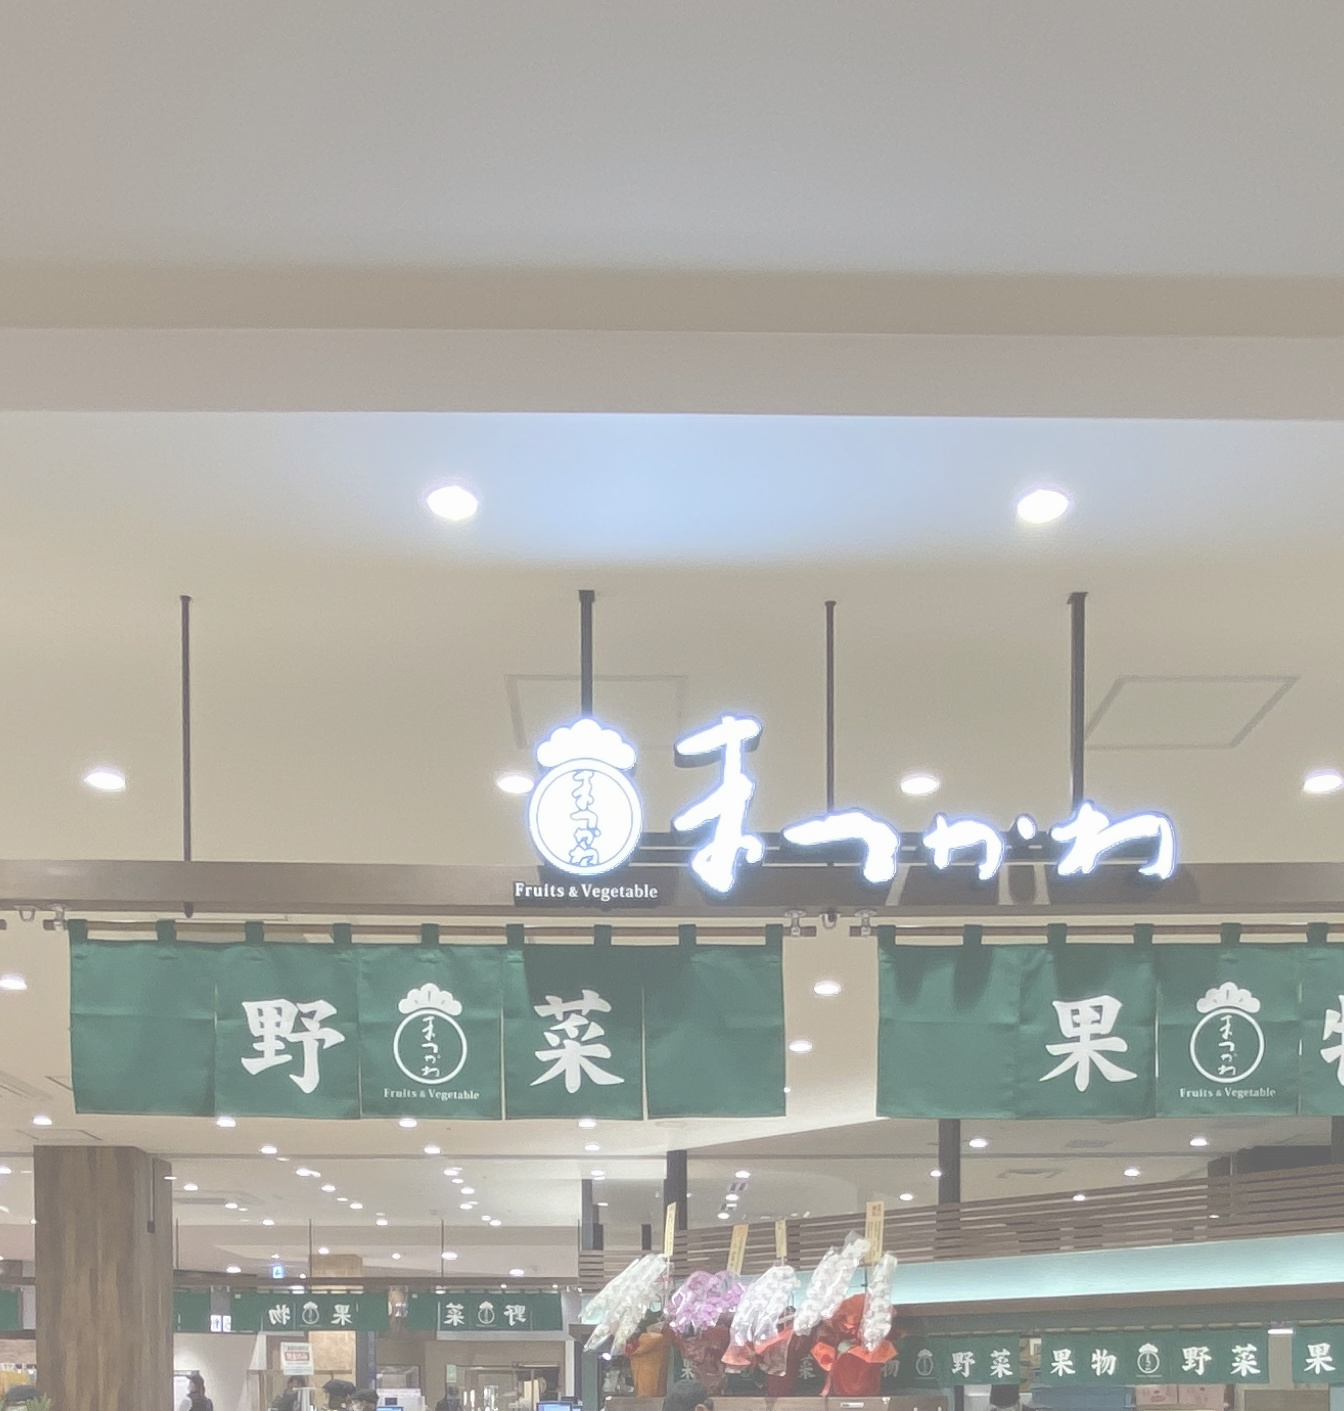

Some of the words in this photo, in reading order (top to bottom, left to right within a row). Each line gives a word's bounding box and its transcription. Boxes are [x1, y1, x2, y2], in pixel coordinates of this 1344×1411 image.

[672, 714, 1176, 894] まつかわ
[514, 882, 565, 898] Fruits
[568, 885, 579, 898] &
[581, 882, 659, 902] Vegetable
[241, 998, 345, 1094] 野
[530, 989, 625, 1093] 菜
[1039, 995, 1137, 1092] 果
